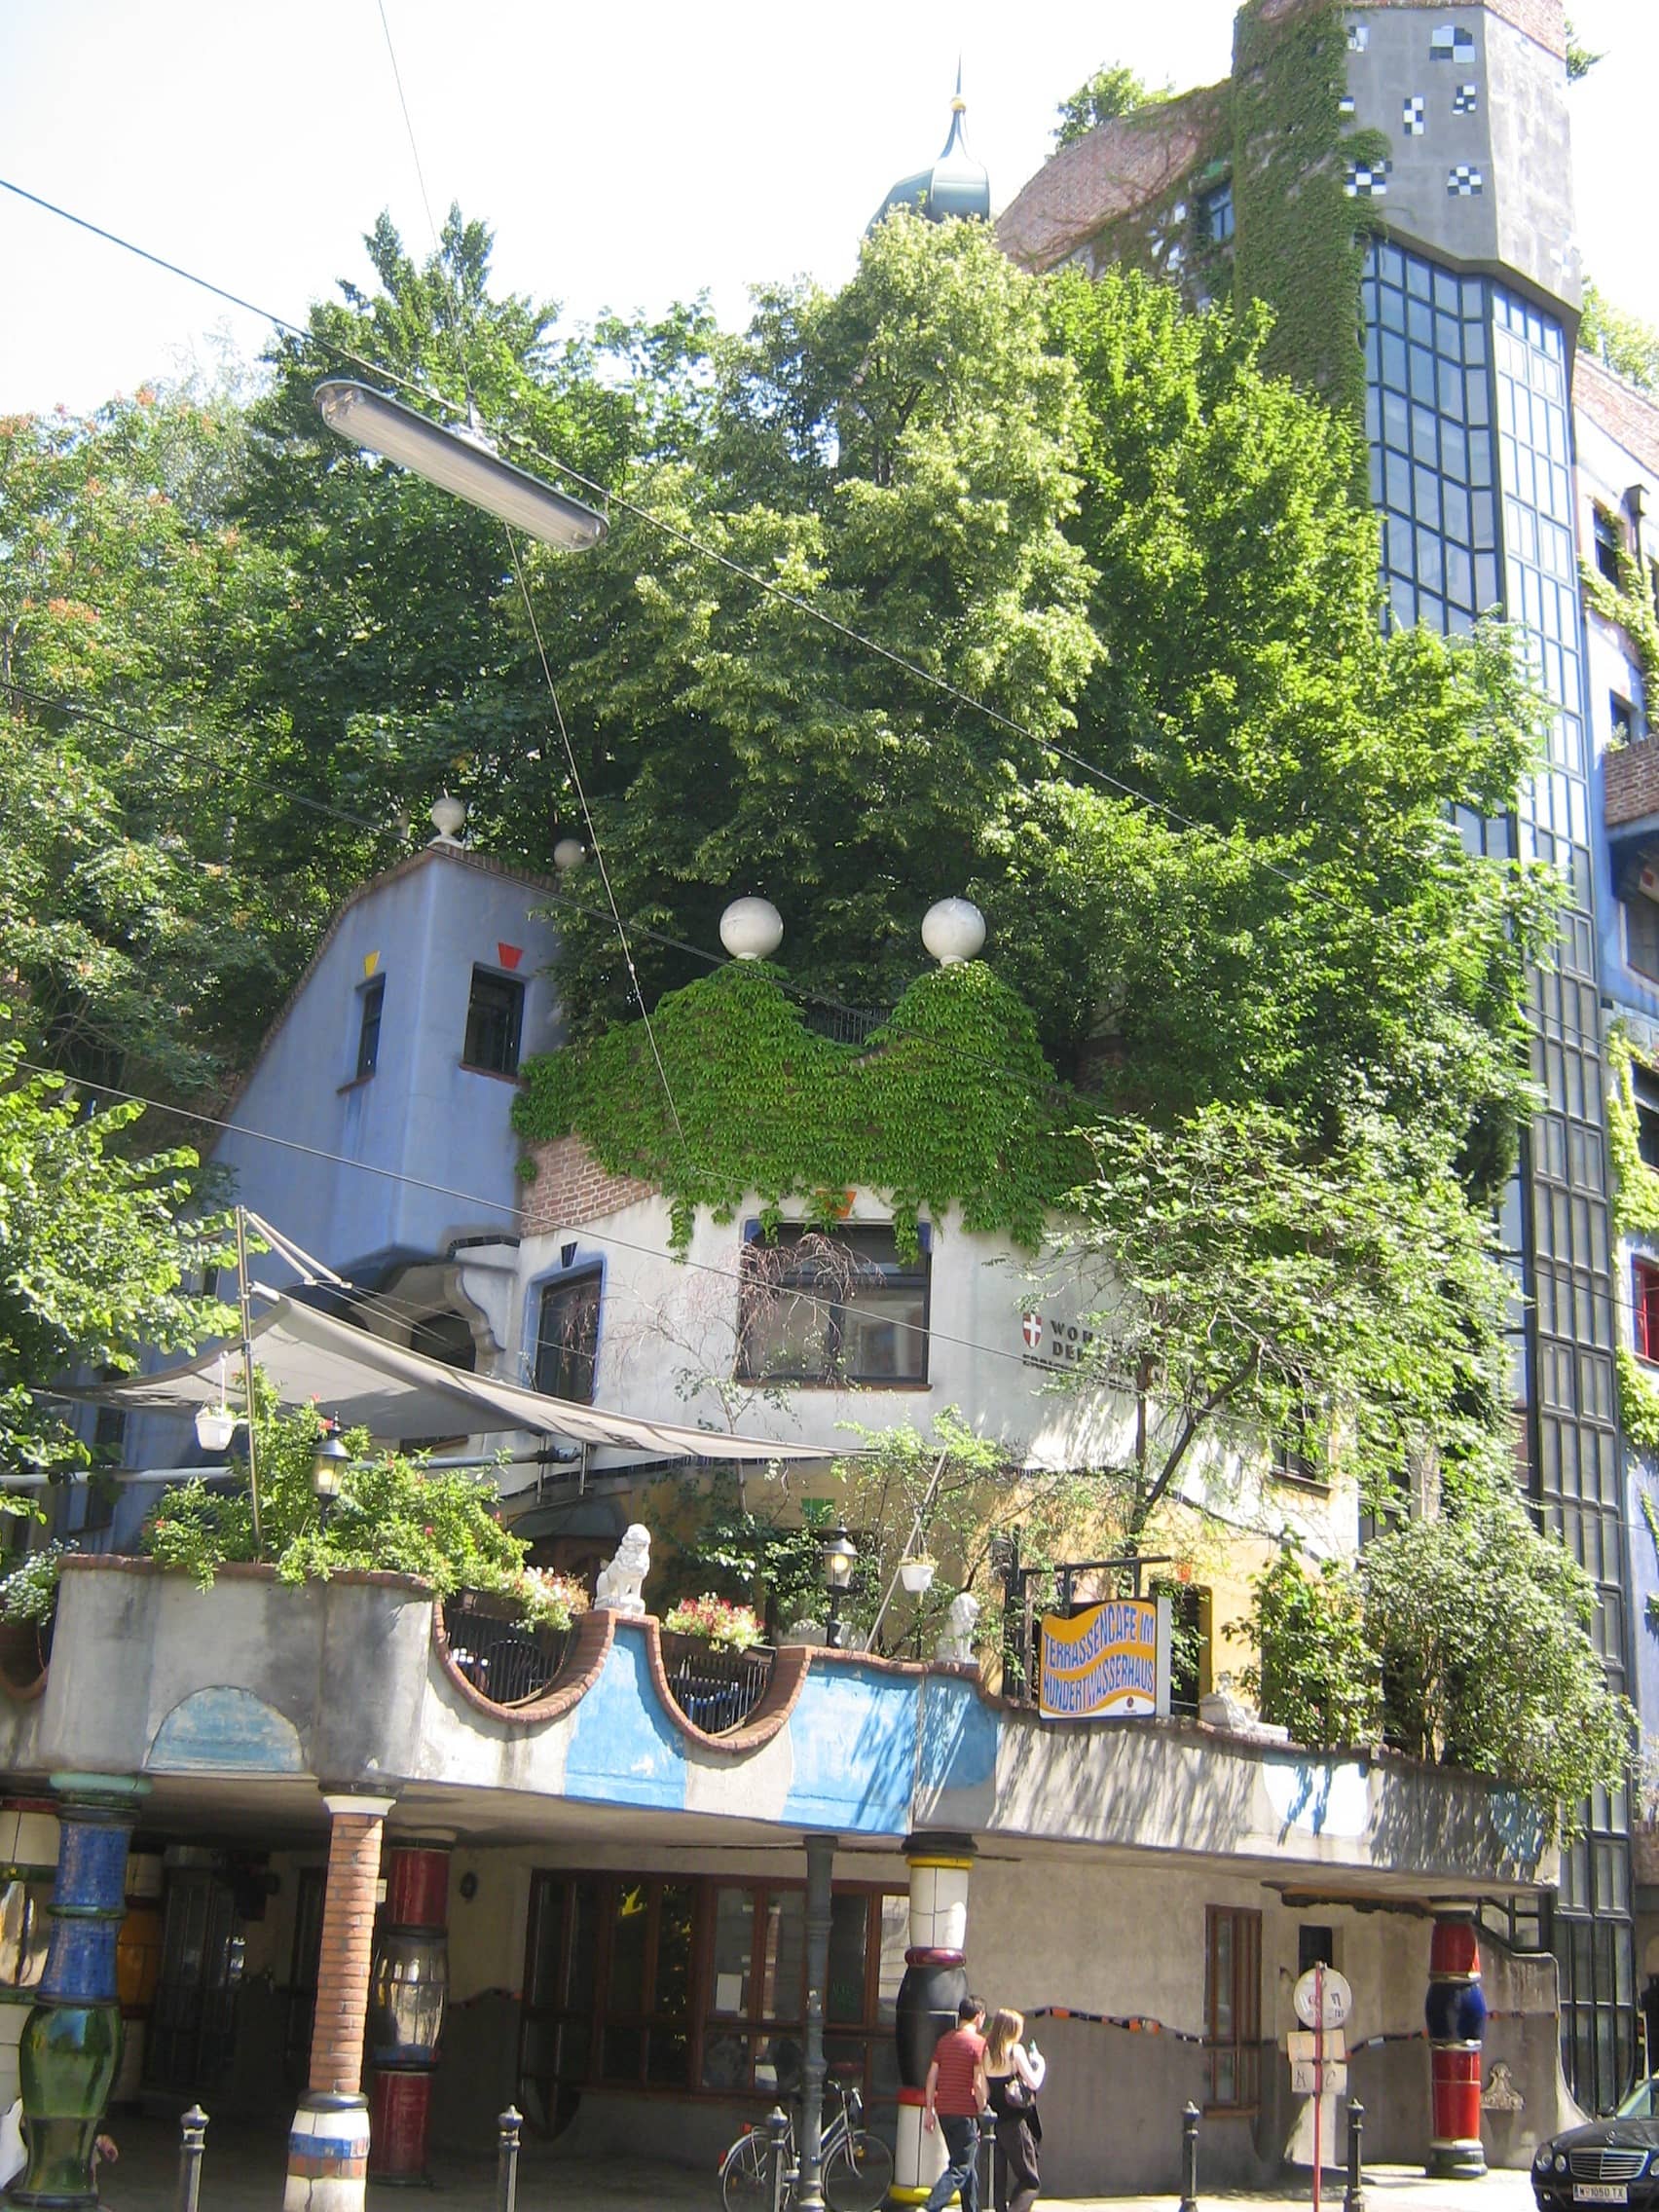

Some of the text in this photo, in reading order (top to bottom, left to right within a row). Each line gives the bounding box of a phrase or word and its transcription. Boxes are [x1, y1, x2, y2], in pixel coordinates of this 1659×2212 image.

[1044, 1604, 1154, 1670] TERRASSENCAFE IM
[1044, 1653, 1154, 1712] HUNDERTWASSERHAUS
